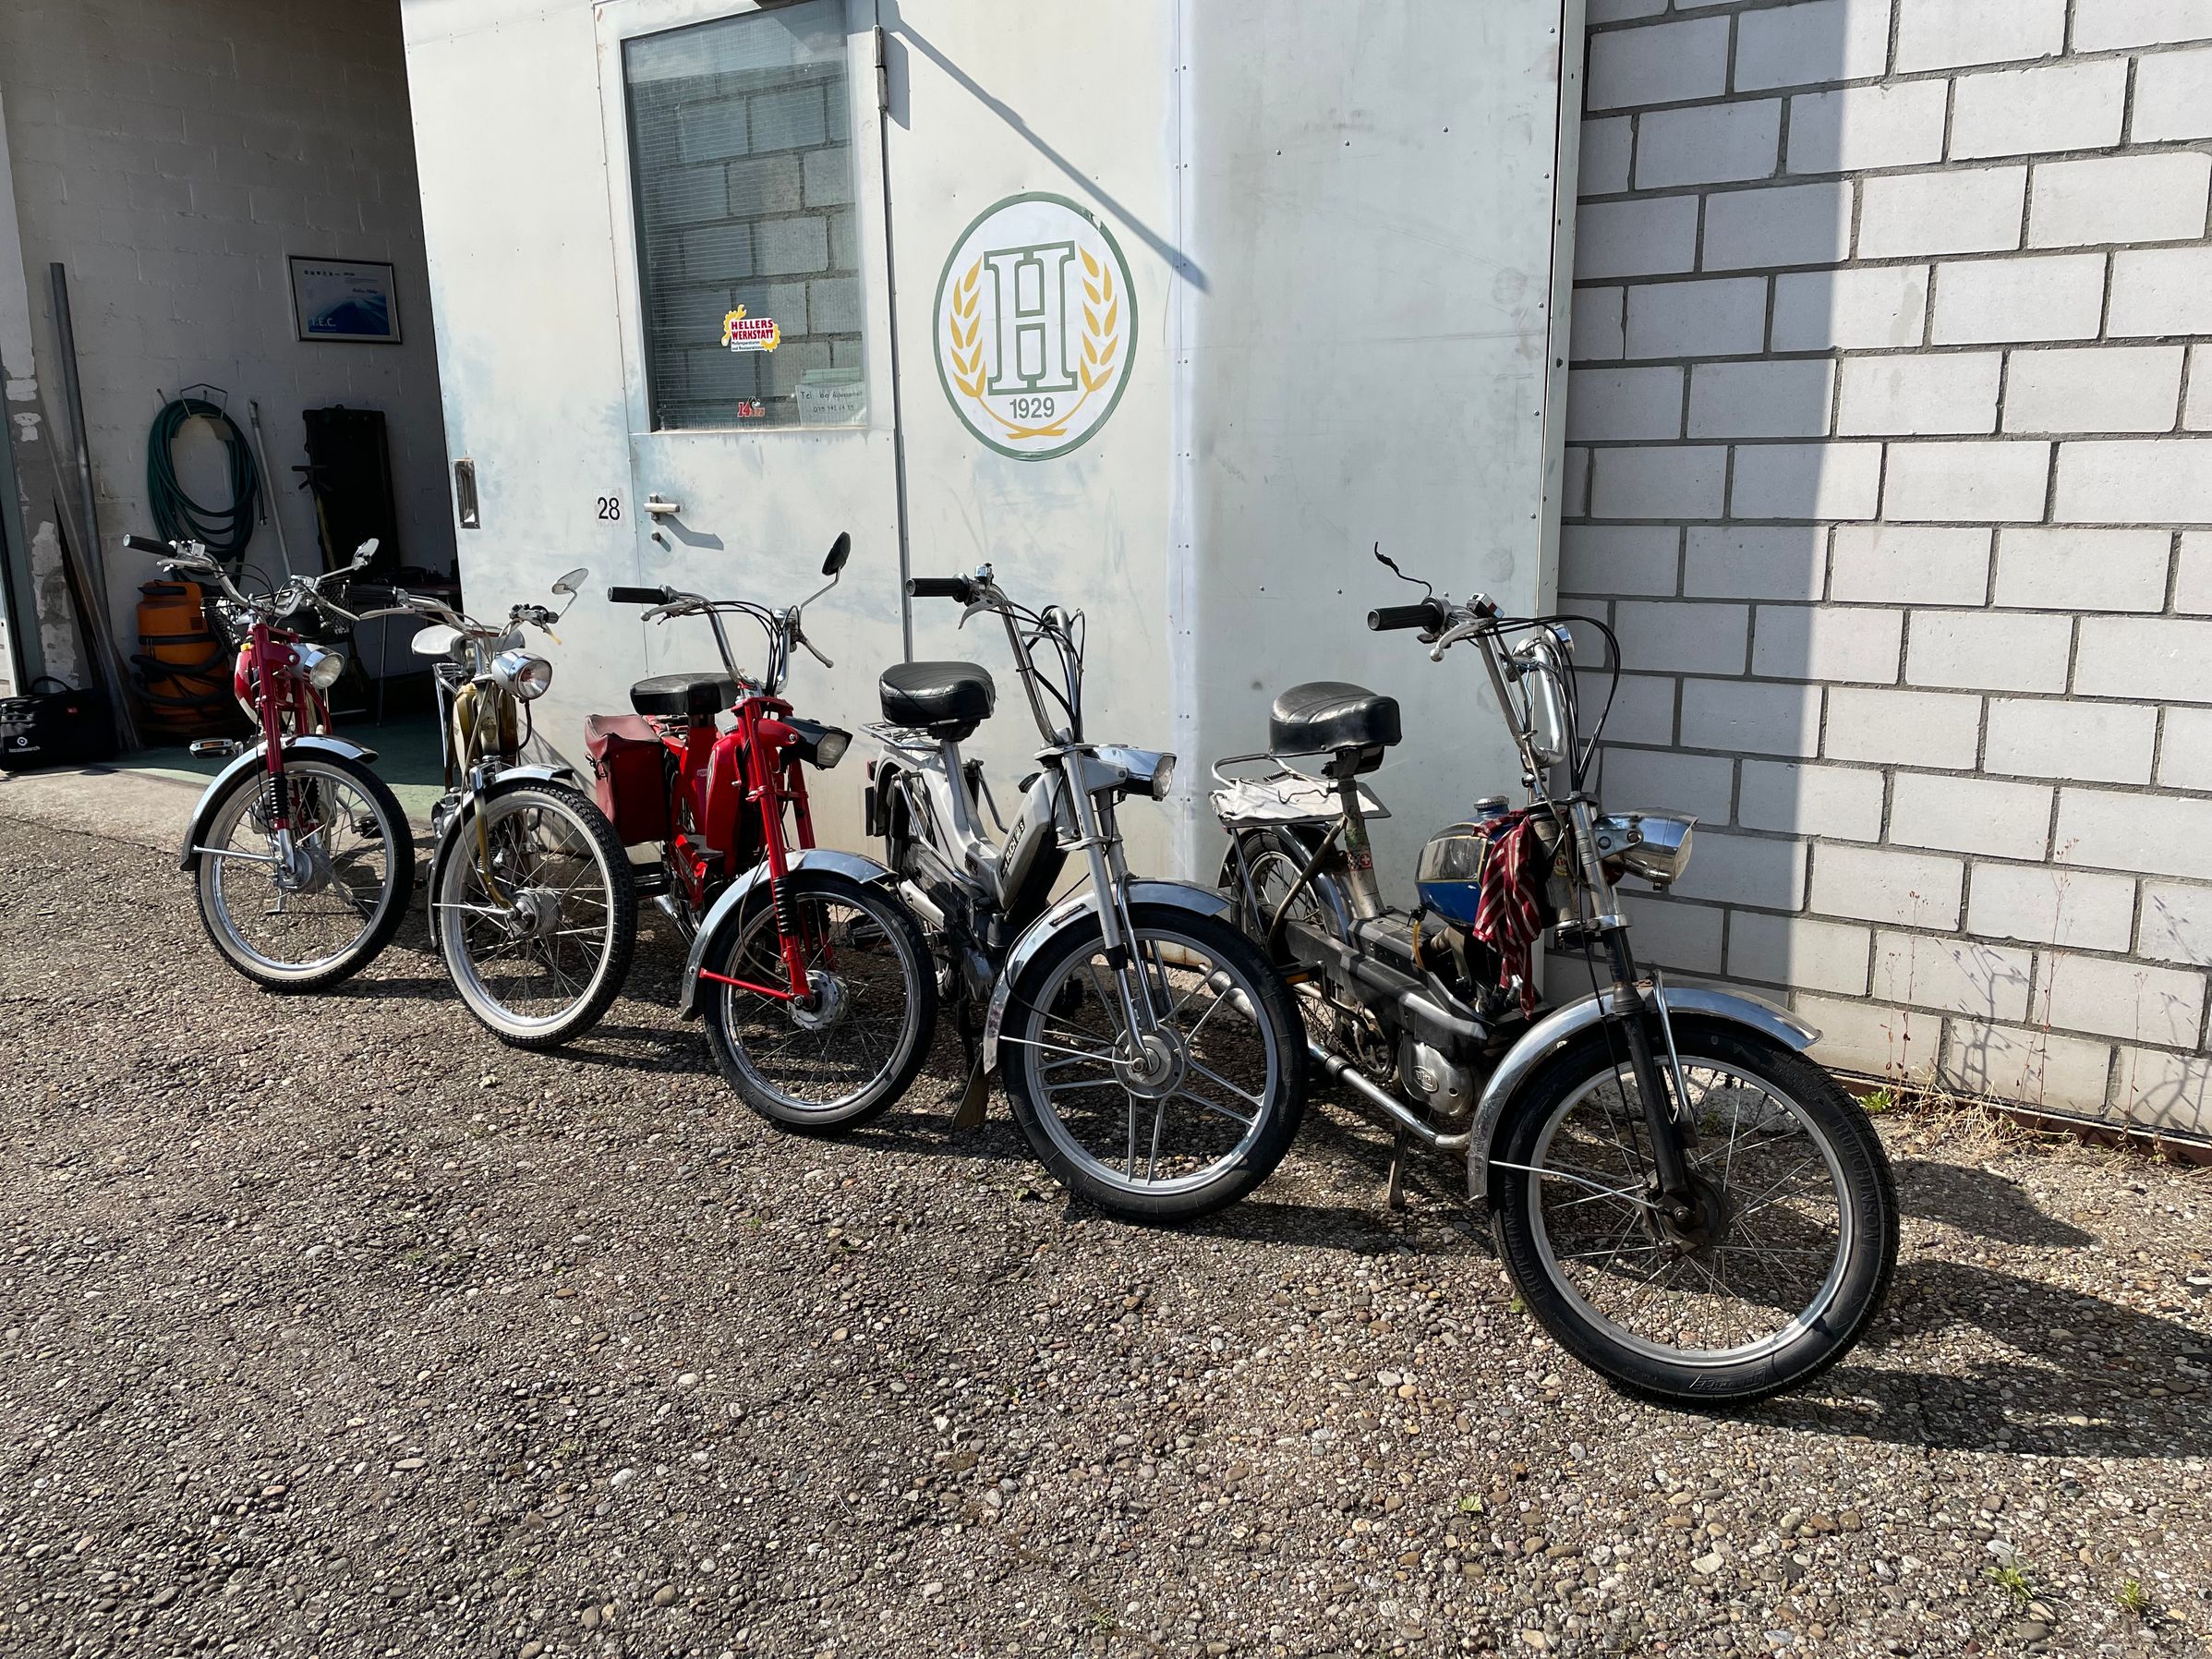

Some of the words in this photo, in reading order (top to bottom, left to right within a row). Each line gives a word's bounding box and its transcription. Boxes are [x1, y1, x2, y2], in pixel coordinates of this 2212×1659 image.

[731, 320, 773, 330] HELLERS
[984, 240, 1078, 395] H
[731, 329, 774, 340] WERKSTATT
[1009, 396, 1055, 418] 1929
[598, 496, 621, 521] 28
